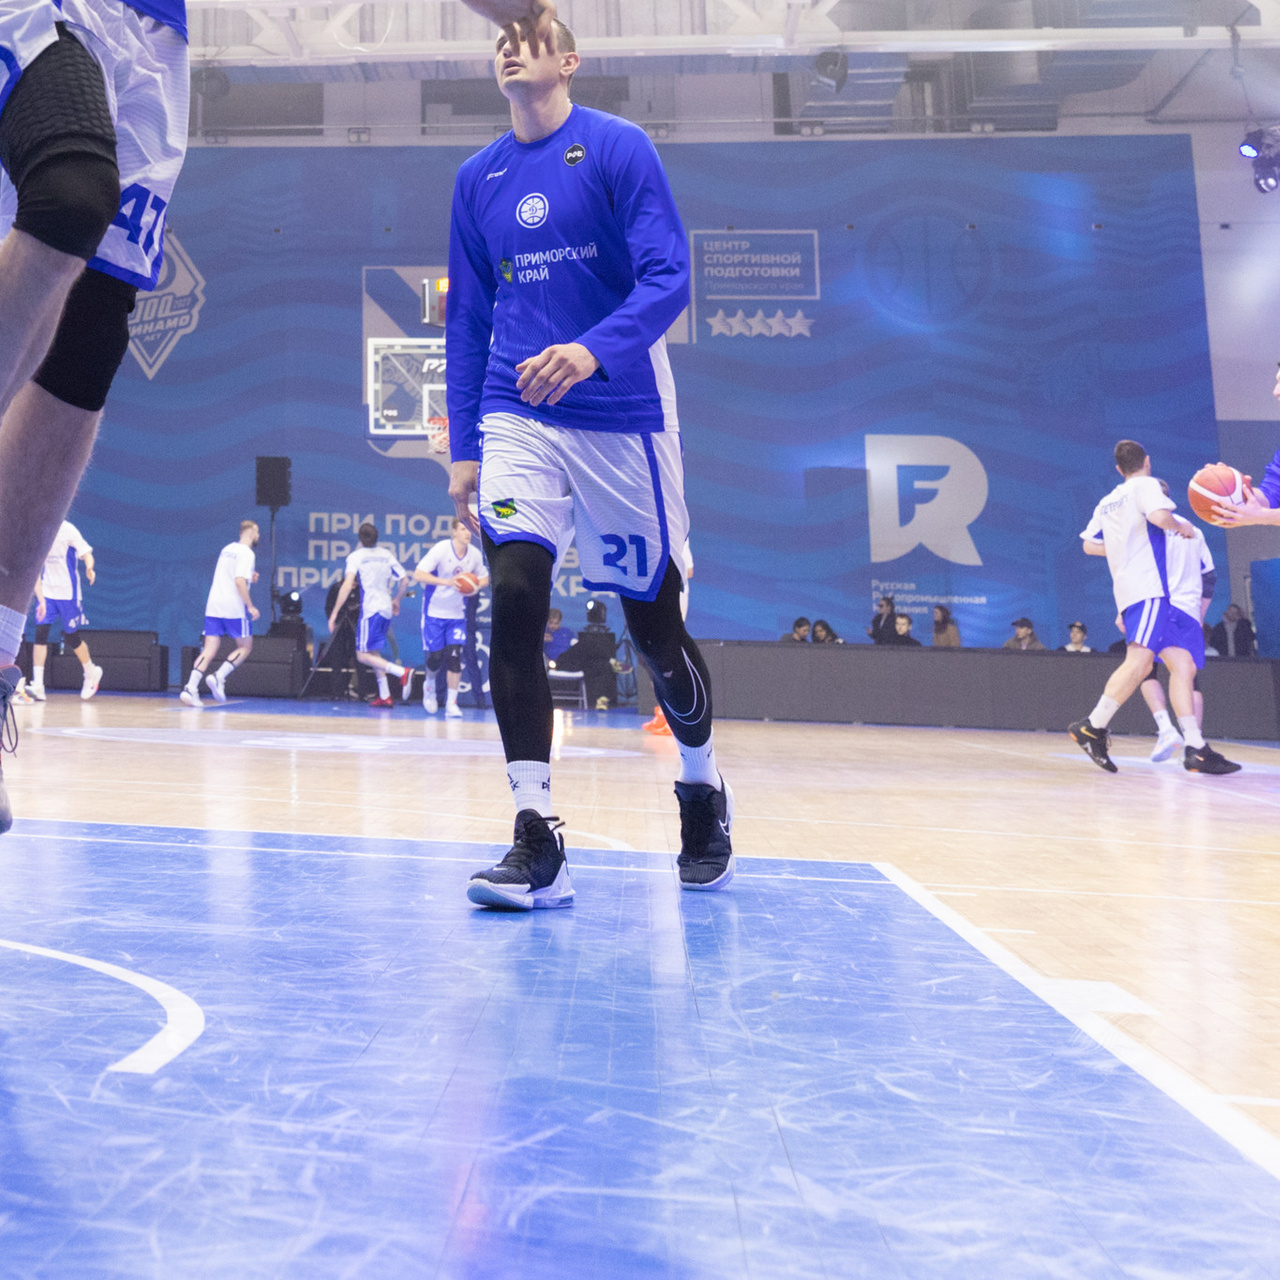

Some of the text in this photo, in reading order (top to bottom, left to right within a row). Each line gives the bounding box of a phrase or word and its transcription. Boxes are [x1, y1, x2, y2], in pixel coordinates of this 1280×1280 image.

[515, 242, 598, 268] ПРИМОРСКИЙ
[703, 241, 750, 252] ЦЕНТР
[703, 252, 801, 264] СПОРТИВНОЙ
[517, 265, 549, 284] КРАЙ
[704, 267, 800, 278] ПОДГОТОВКИ
[309, 512, 375, 533] ПРИ
[600, 533, 648, 577] 21
